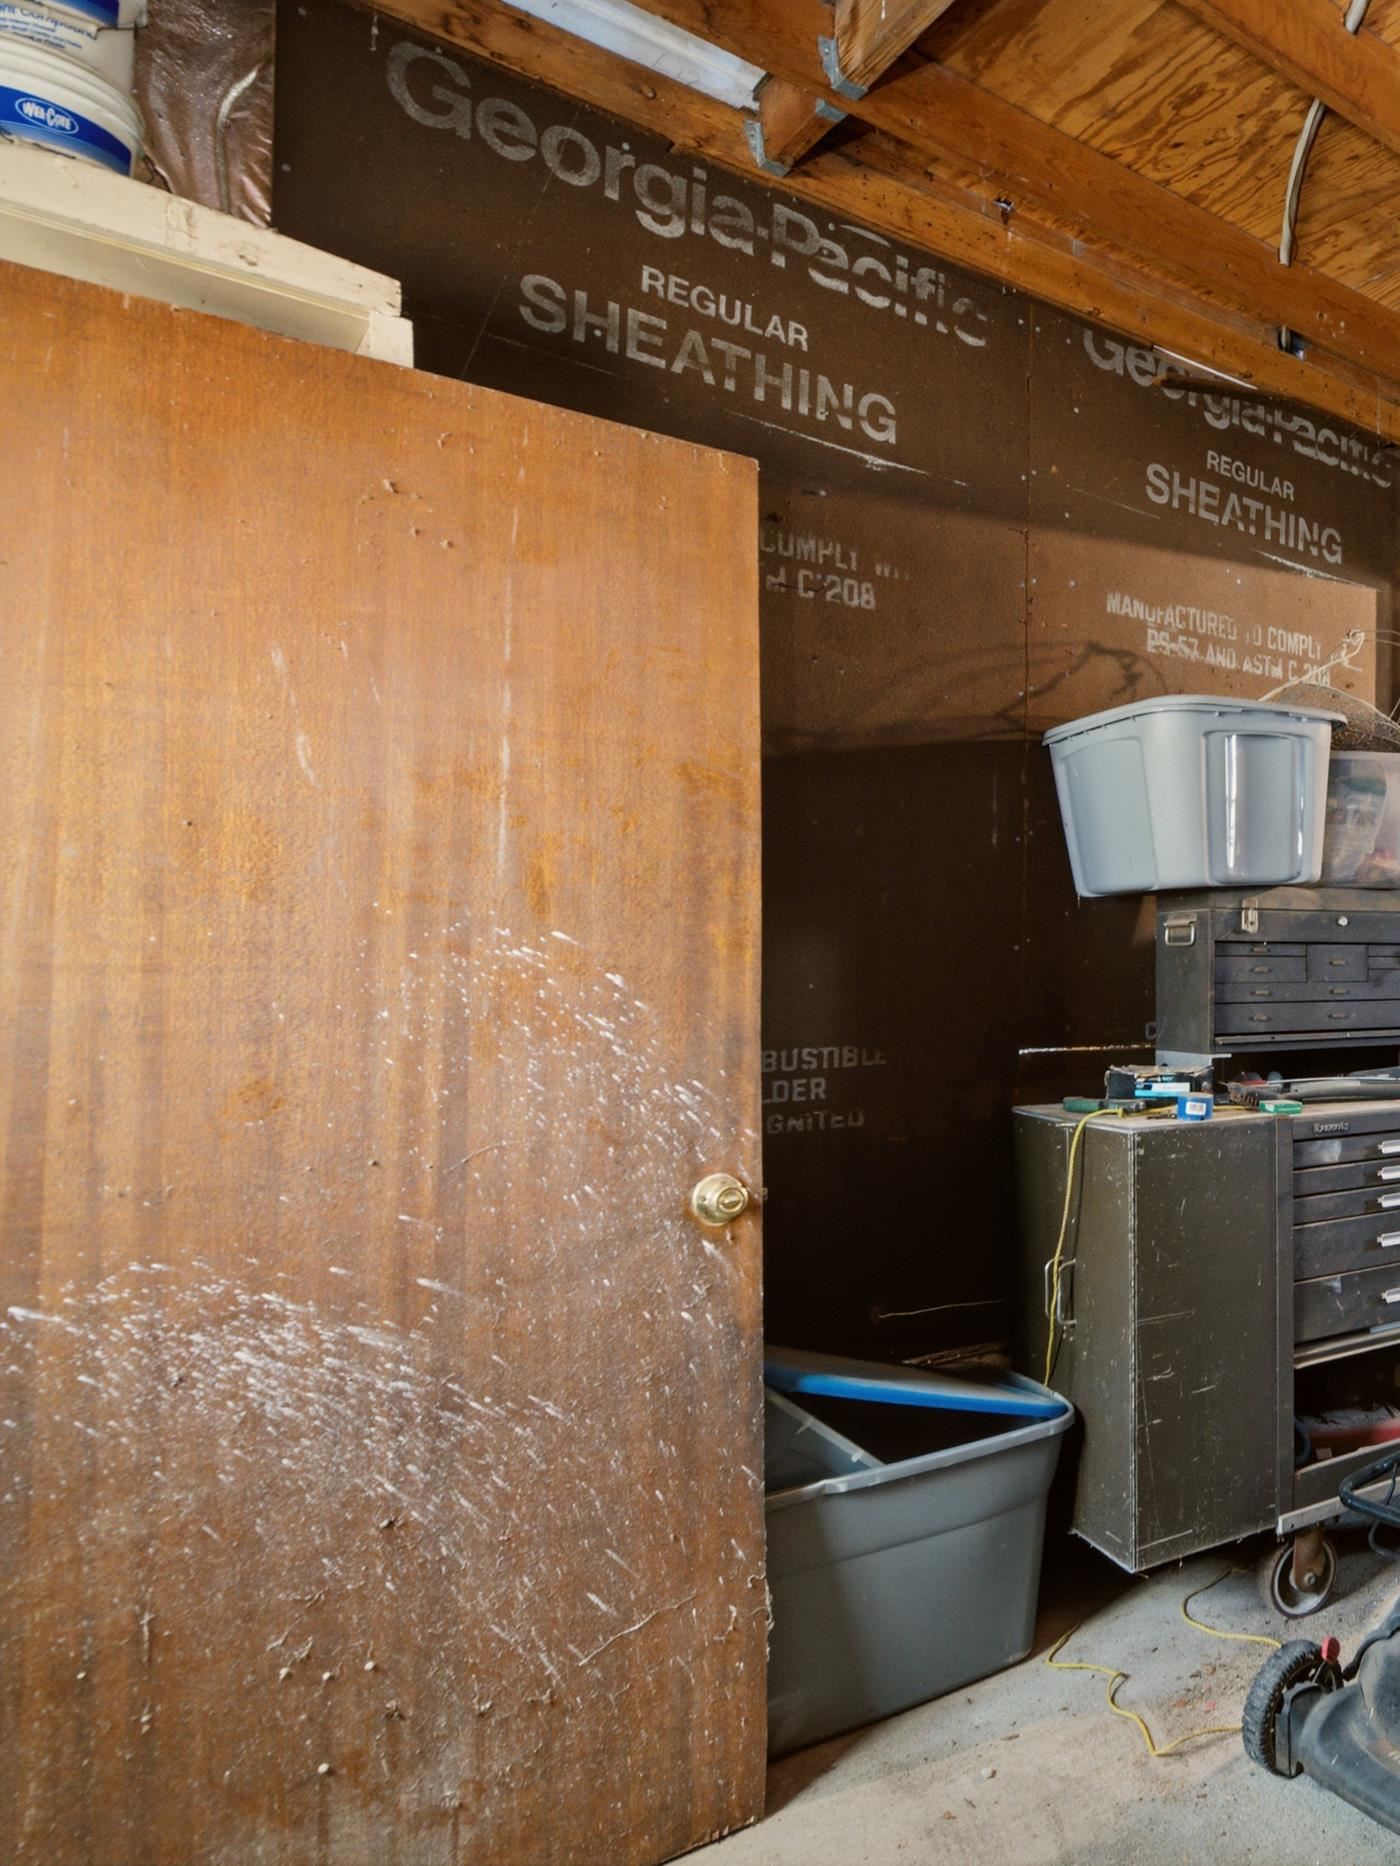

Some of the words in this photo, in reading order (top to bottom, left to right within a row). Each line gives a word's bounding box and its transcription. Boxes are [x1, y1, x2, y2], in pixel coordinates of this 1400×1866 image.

[641, 265, 809, 351] REGULAR
[519, 274, 897, 443] SHEATHING
[1083, 329, 1391, 488] Gegia-Pacific
[1146, 463, 1343, 565] SHEATHING
[1206, 450, 1295, 501] REGULAR
[1267, 626, 1322, 661] COMPLY
